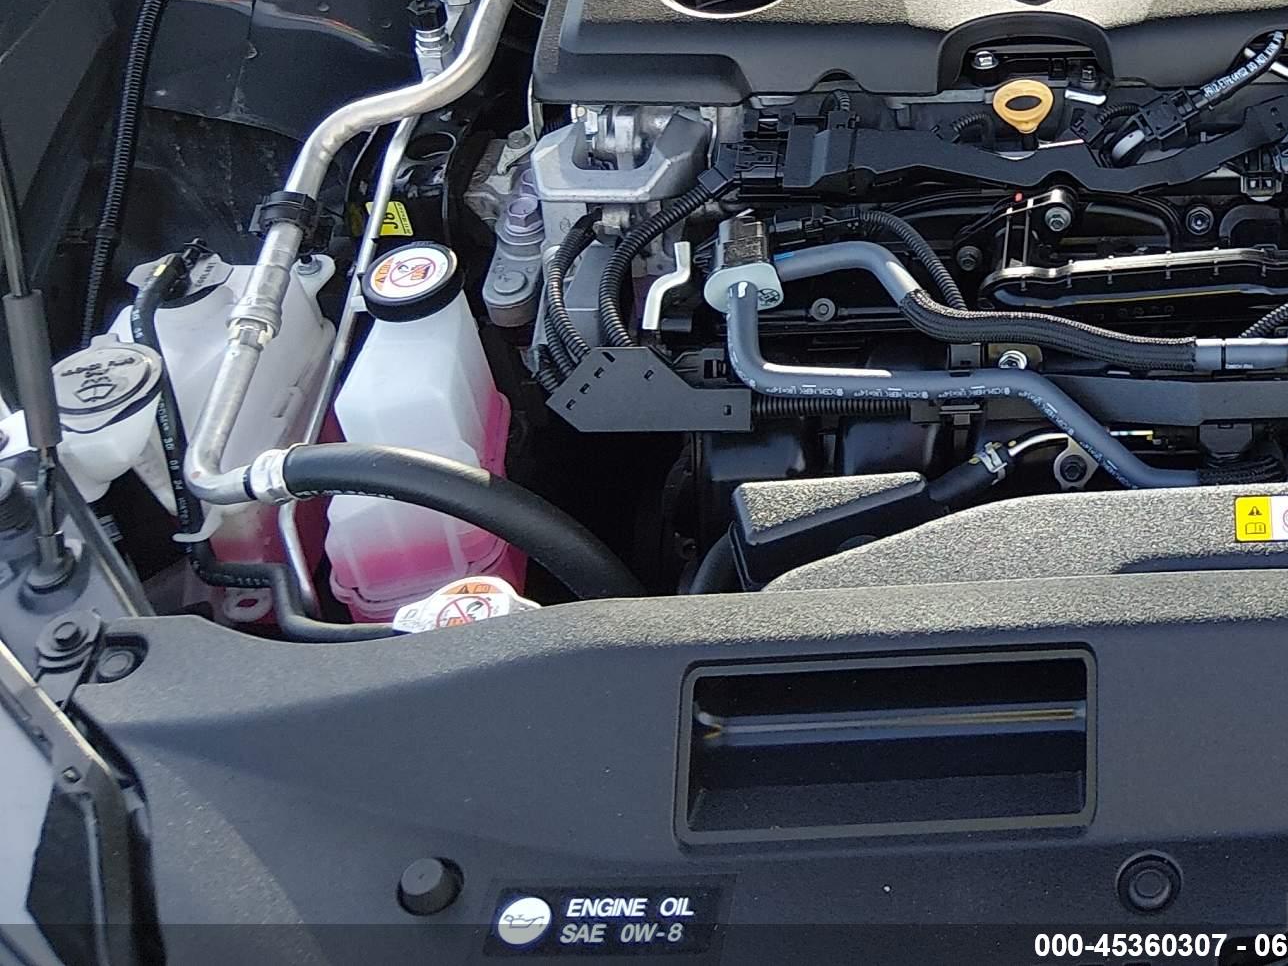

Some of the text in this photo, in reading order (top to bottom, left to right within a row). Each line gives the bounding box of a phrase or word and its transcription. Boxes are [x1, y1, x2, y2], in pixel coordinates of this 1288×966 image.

[566, 897, 695, 917] ENGINE OIL
[559, 923, 684, 943] SAE 0W-8
